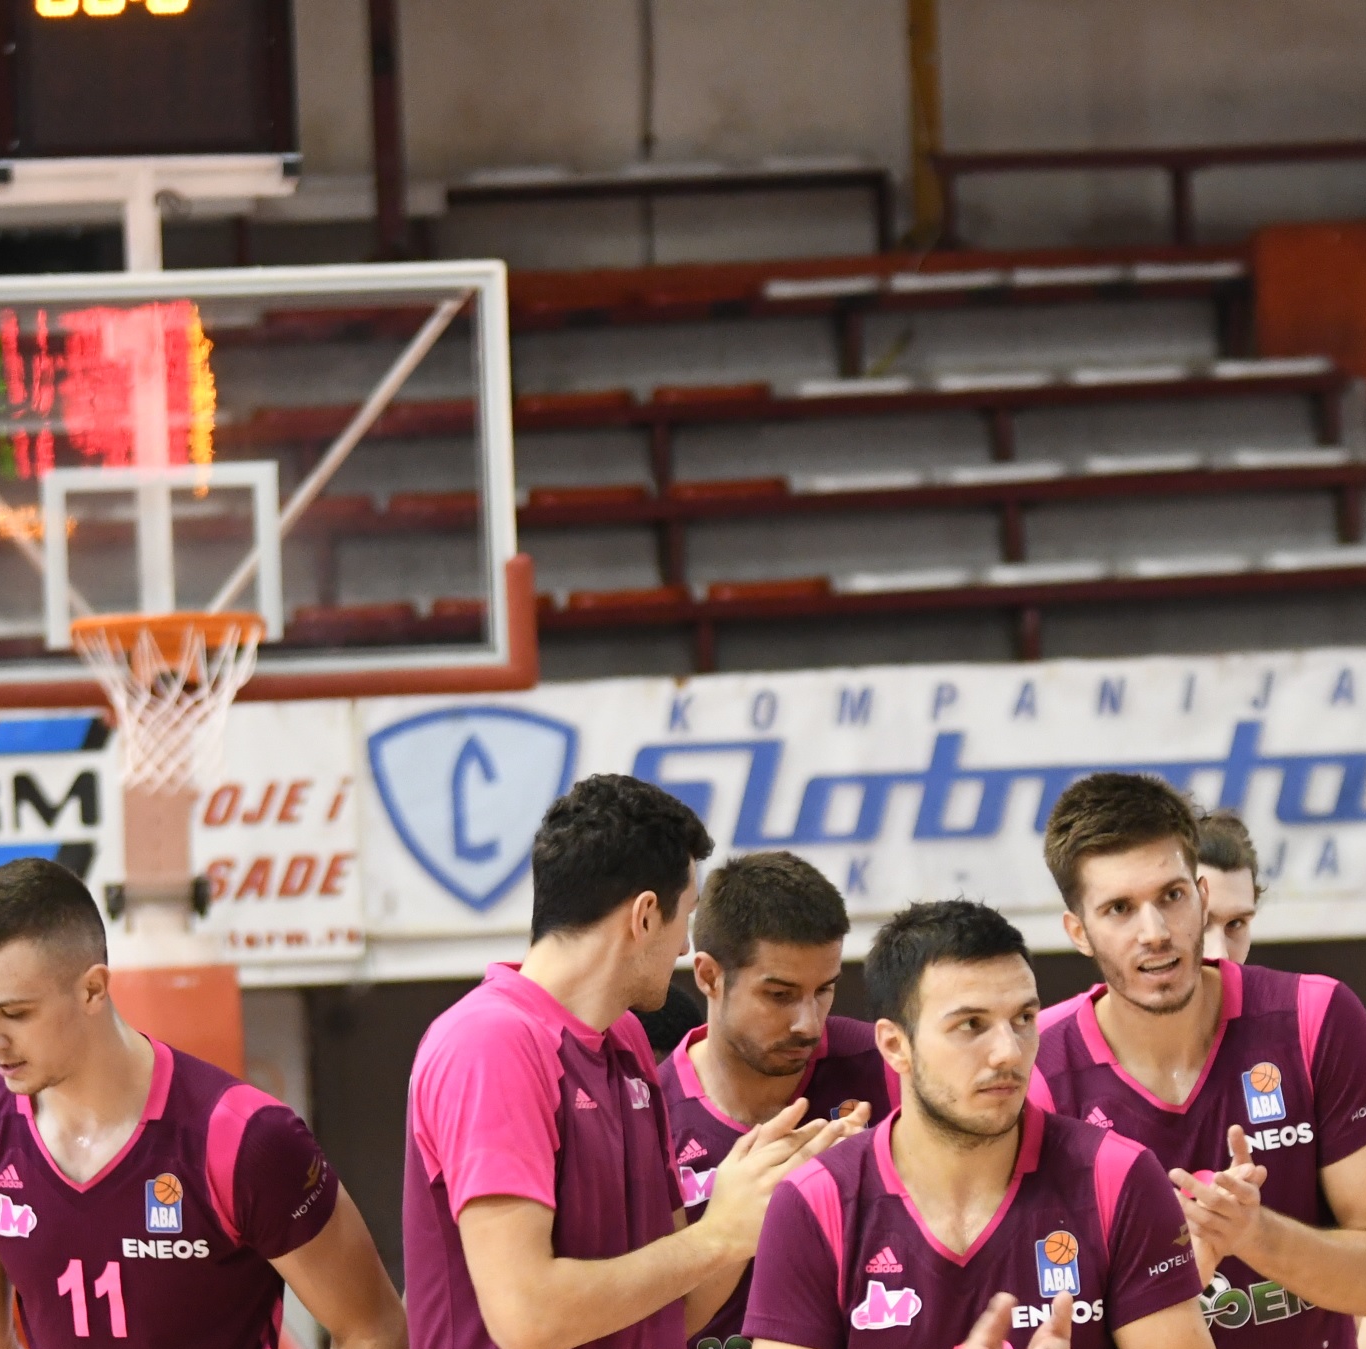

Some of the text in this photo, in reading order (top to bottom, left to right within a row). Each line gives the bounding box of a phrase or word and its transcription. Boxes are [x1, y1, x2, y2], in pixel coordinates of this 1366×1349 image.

[667, 666, 1356, 734] KOMPANIJA
[202, 778, 314, 828] OJE
[1249, 1092, 1283, 1119] ABA
[1230, 1122, 1314, 1158] NEOS
[677, 1148, 708, 1164] adidas
[150, 1206, 178, 1228] ABA
[121, 1238, 210, 1260] ENEOS
[865, 1261, 903, 1273] adidas
[1043, 1266, 1077, 1292] ABA
[56, 1258, 128, 1338] 11
